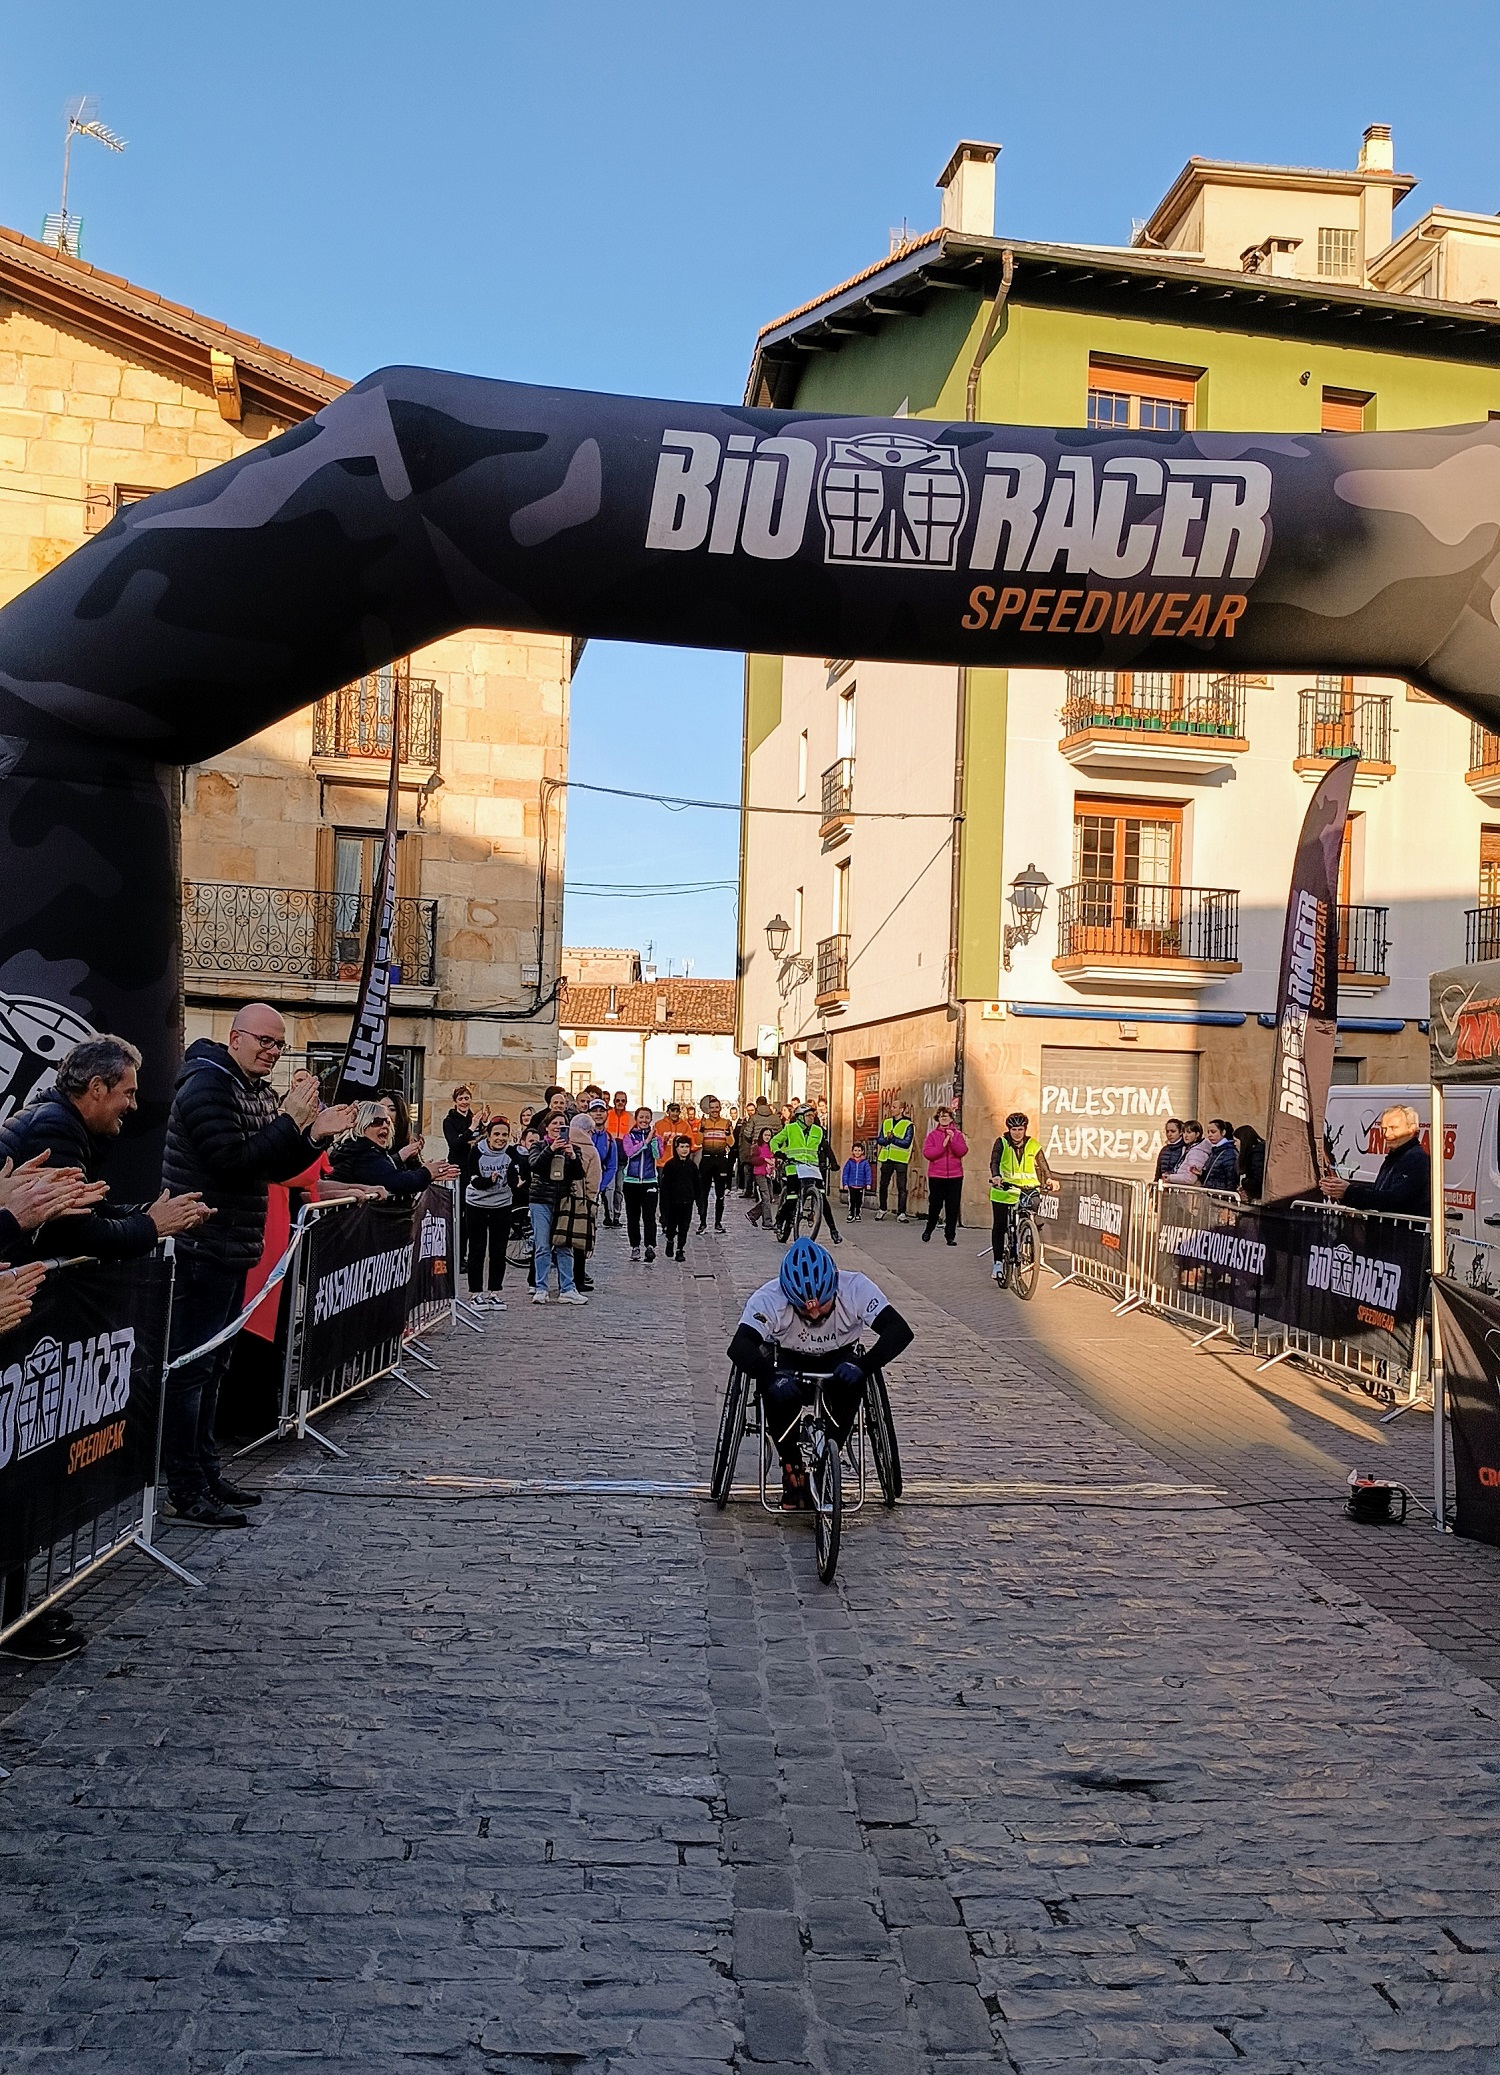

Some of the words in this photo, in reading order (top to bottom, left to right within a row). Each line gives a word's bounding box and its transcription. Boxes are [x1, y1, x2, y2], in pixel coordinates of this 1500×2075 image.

[969, 452, 1273, 579] RACER
[962, 585, 1247, 639] SPEEDWEAR
[1286, 889, 1318, 1005] RACER
[1311, 900, 1328, 1012] SPEEDWEAR
[1044, 1124, 1163, 1162] AURRERA
[1158, 1224, 1266, 1275] #WEMAKEYOUFASTER
[1352, 1253, 1401, 1311] RACER
[810, 1332, 837, 1343] LANA
[1357, 1304, 1395, 1333] SPEEDWEAR
[58, 1327, 135, 1438] RACER
[67, 1420, 127, 1475] SPEEDWEAR
